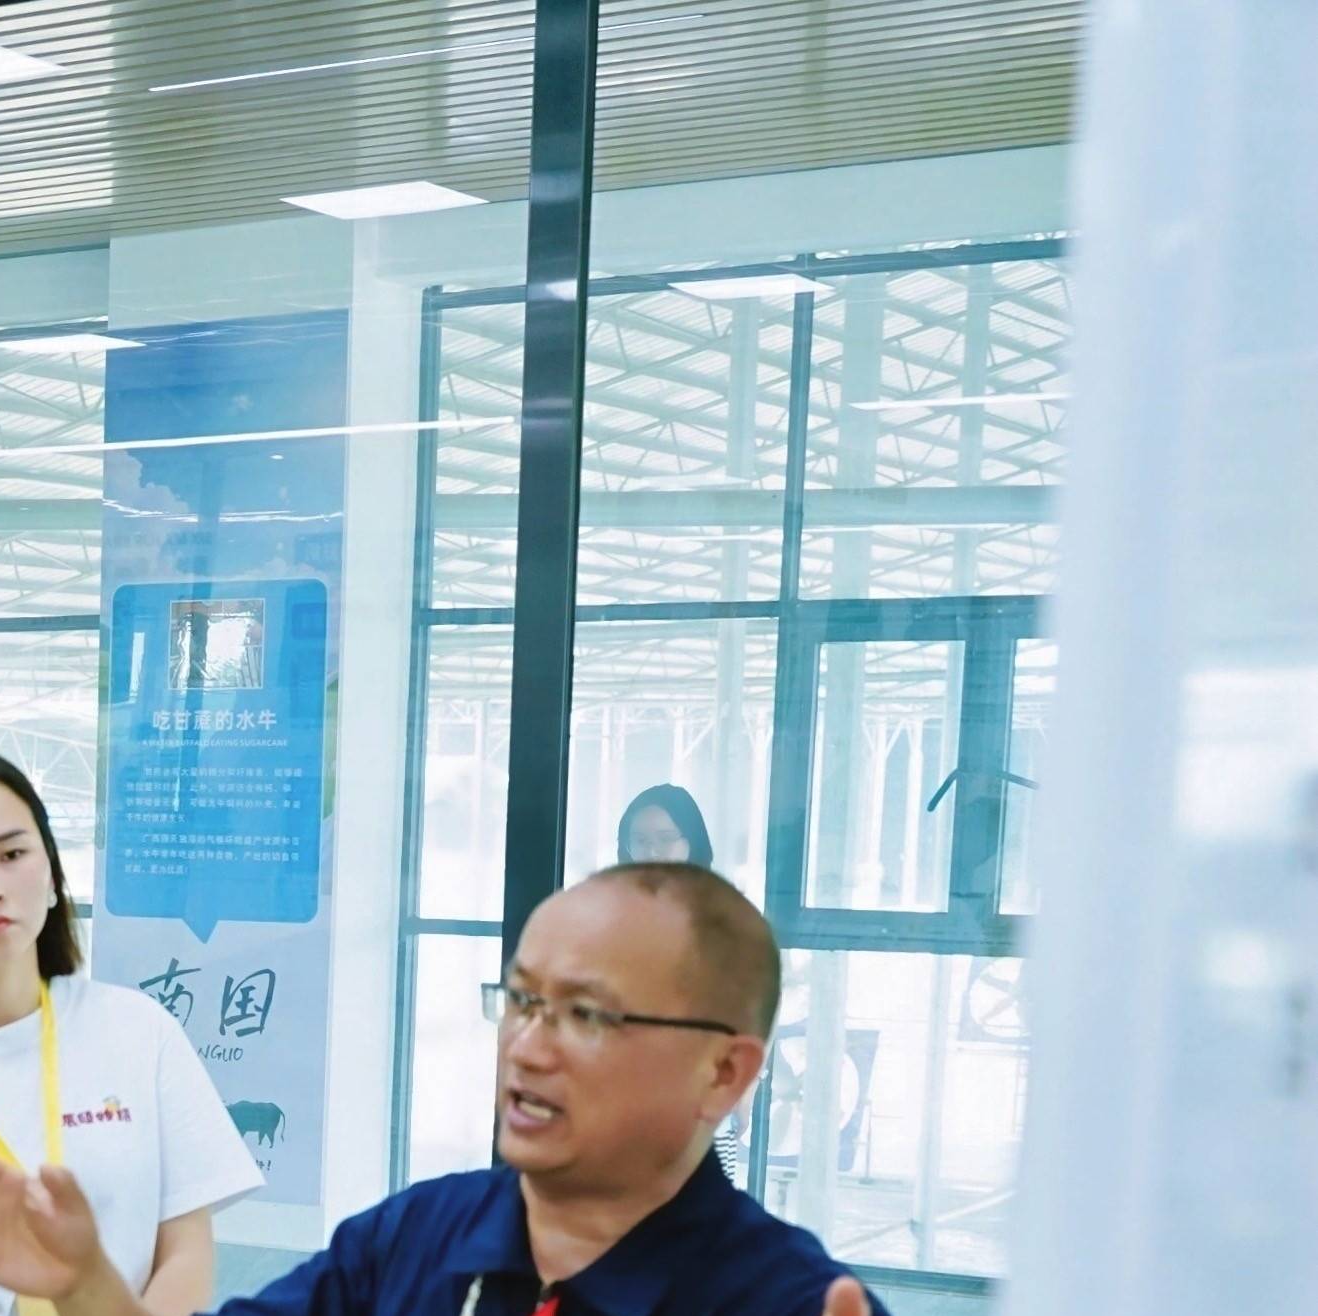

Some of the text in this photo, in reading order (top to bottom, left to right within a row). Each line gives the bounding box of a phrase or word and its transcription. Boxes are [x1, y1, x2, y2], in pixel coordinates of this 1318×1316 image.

[152, 708, 278, 732] 吃甘蔗的水牛
[240, 738, 288, 748] SUGARCANE
